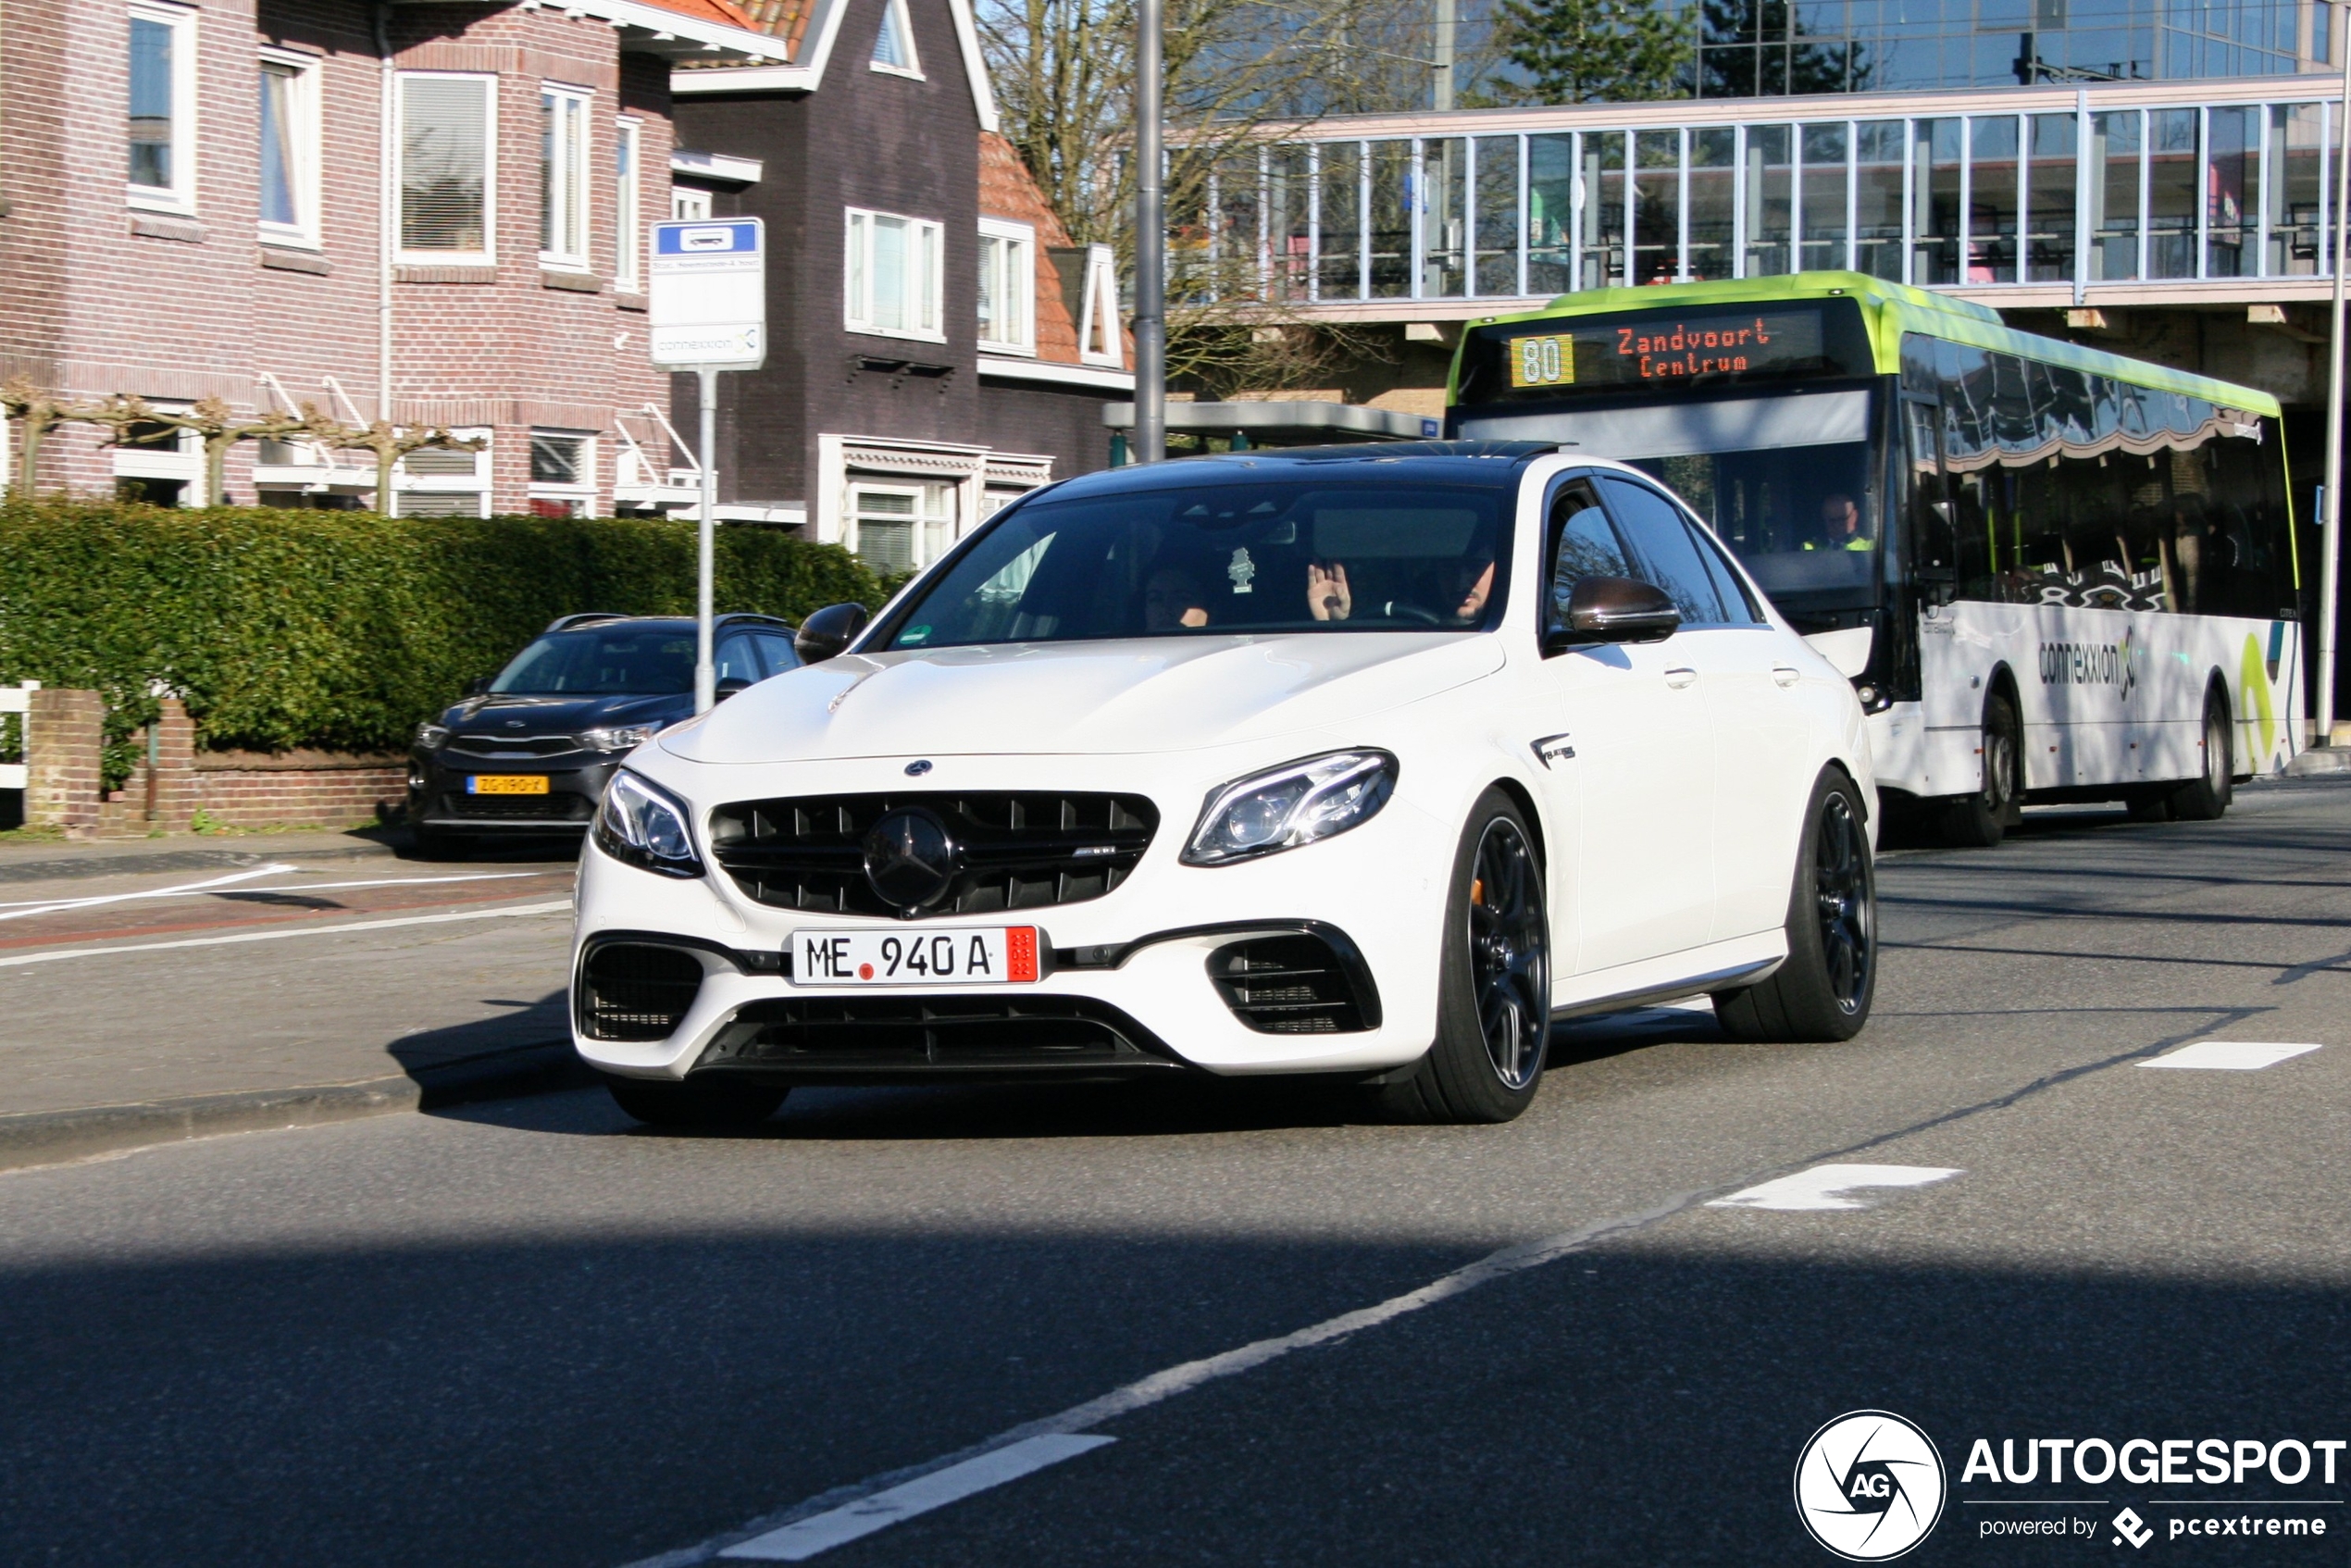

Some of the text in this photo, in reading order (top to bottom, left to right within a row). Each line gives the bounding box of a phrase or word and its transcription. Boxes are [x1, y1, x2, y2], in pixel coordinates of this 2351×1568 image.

[1617, 317, 1770, 355] Zandvoort
[1522, 337, 1561, 383] 80
[1639, 354, 1748, 378] Centrum
[2039, 640, 2119, 686] connexxion
[1012, 934, 1029, 946] 23
[1012, 948, 1029, 961] 03
[806, 935, 991, 977] ME 940 A
[1013, 963, 1029, 976] 22
